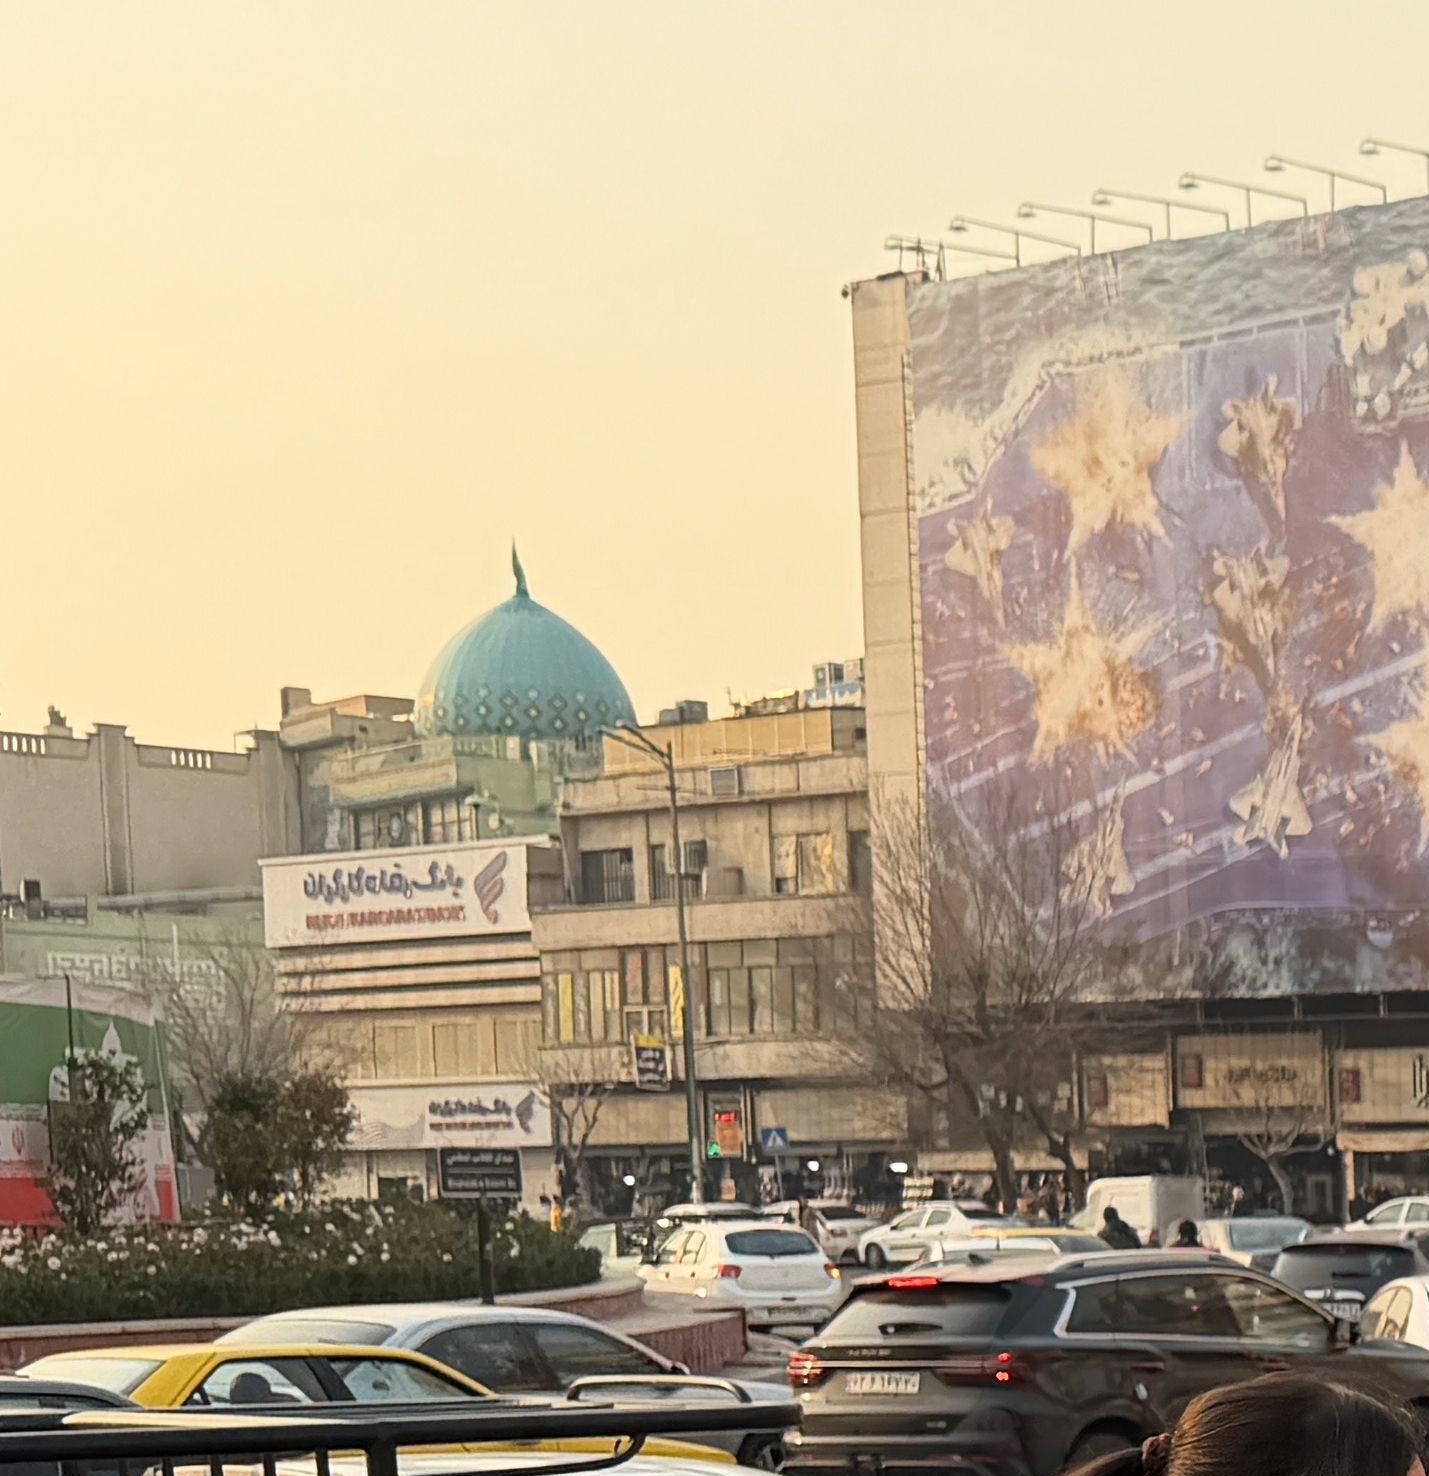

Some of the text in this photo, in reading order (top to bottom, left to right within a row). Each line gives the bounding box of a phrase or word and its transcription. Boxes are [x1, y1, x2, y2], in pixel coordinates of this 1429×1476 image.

[303, 861, 465, 906] بانک رفاه کارگران
